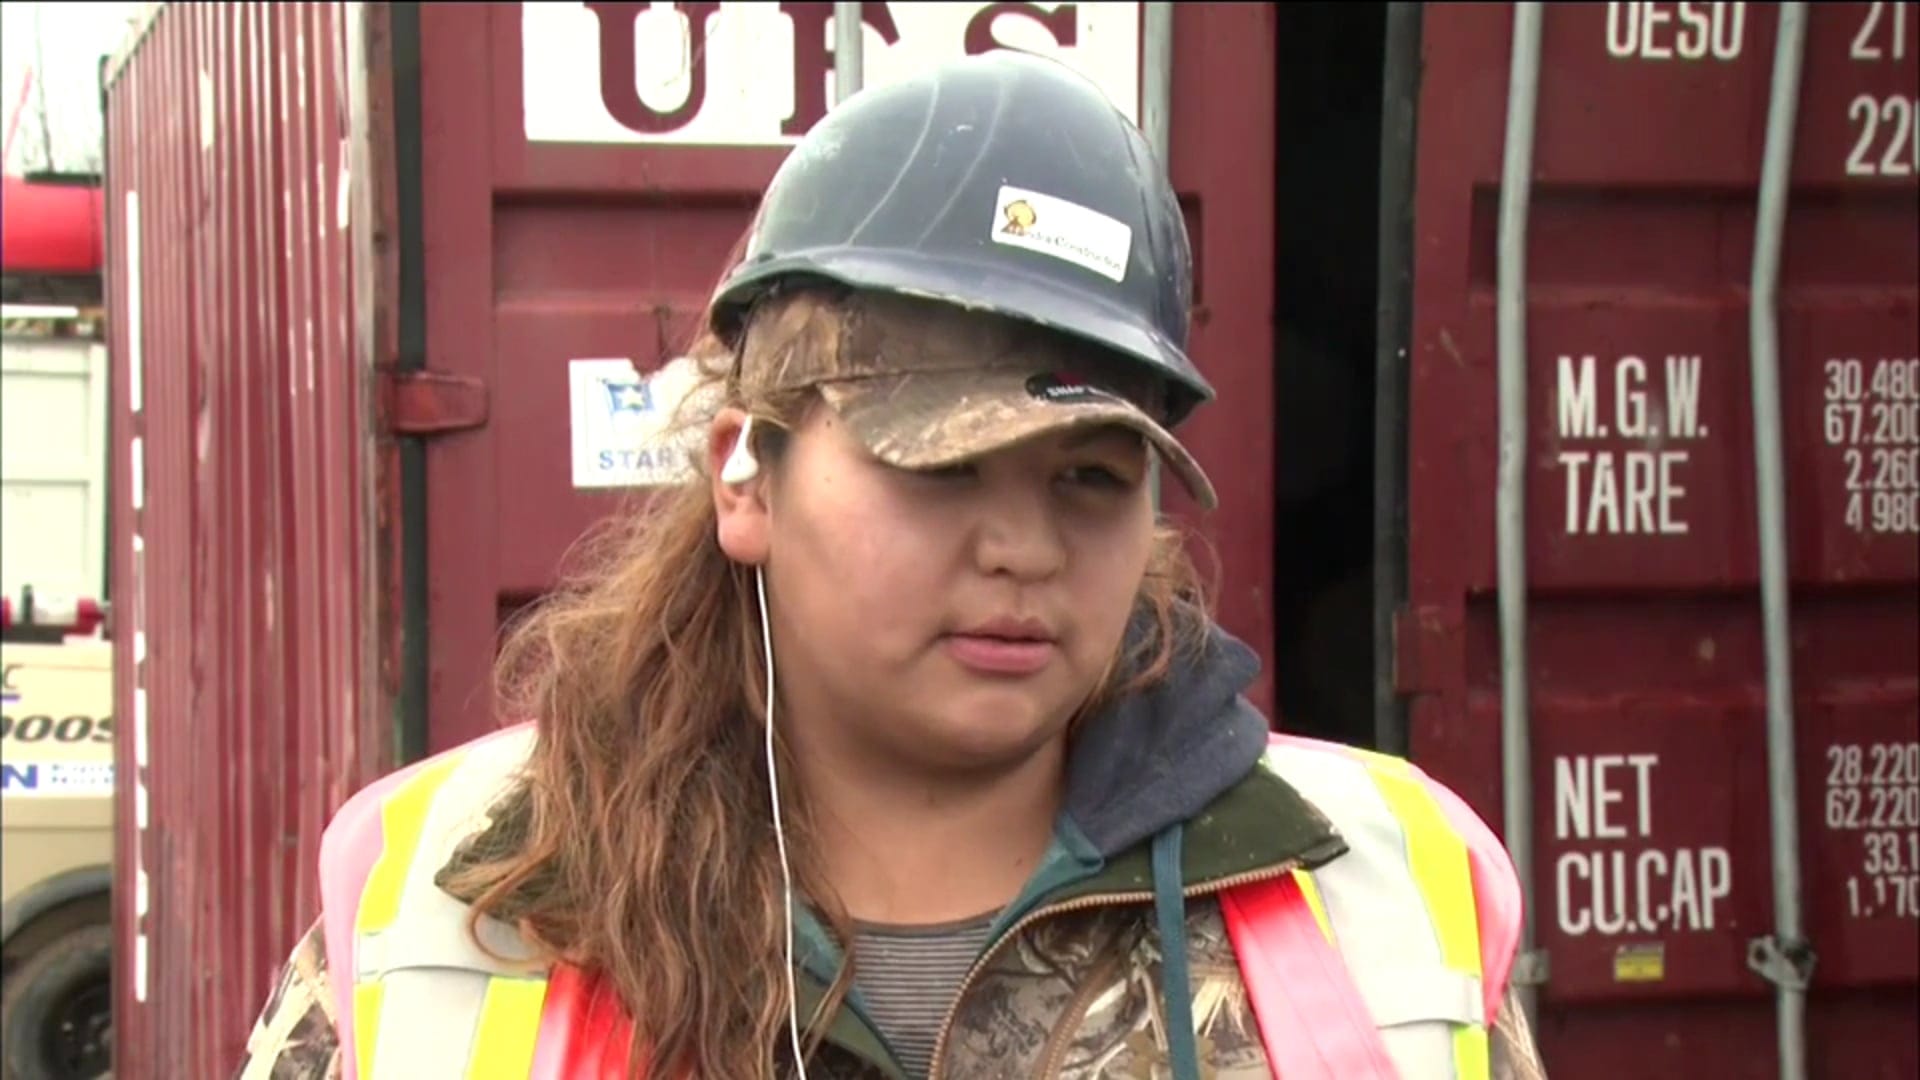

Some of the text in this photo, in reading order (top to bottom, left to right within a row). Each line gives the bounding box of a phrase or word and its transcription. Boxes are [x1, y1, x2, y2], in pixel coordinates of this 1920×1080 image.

[1845, 94, 1918, 175] 22
[1557, 452, 1689, 534] TARE
[1554, 753, 1659, 839] NET
